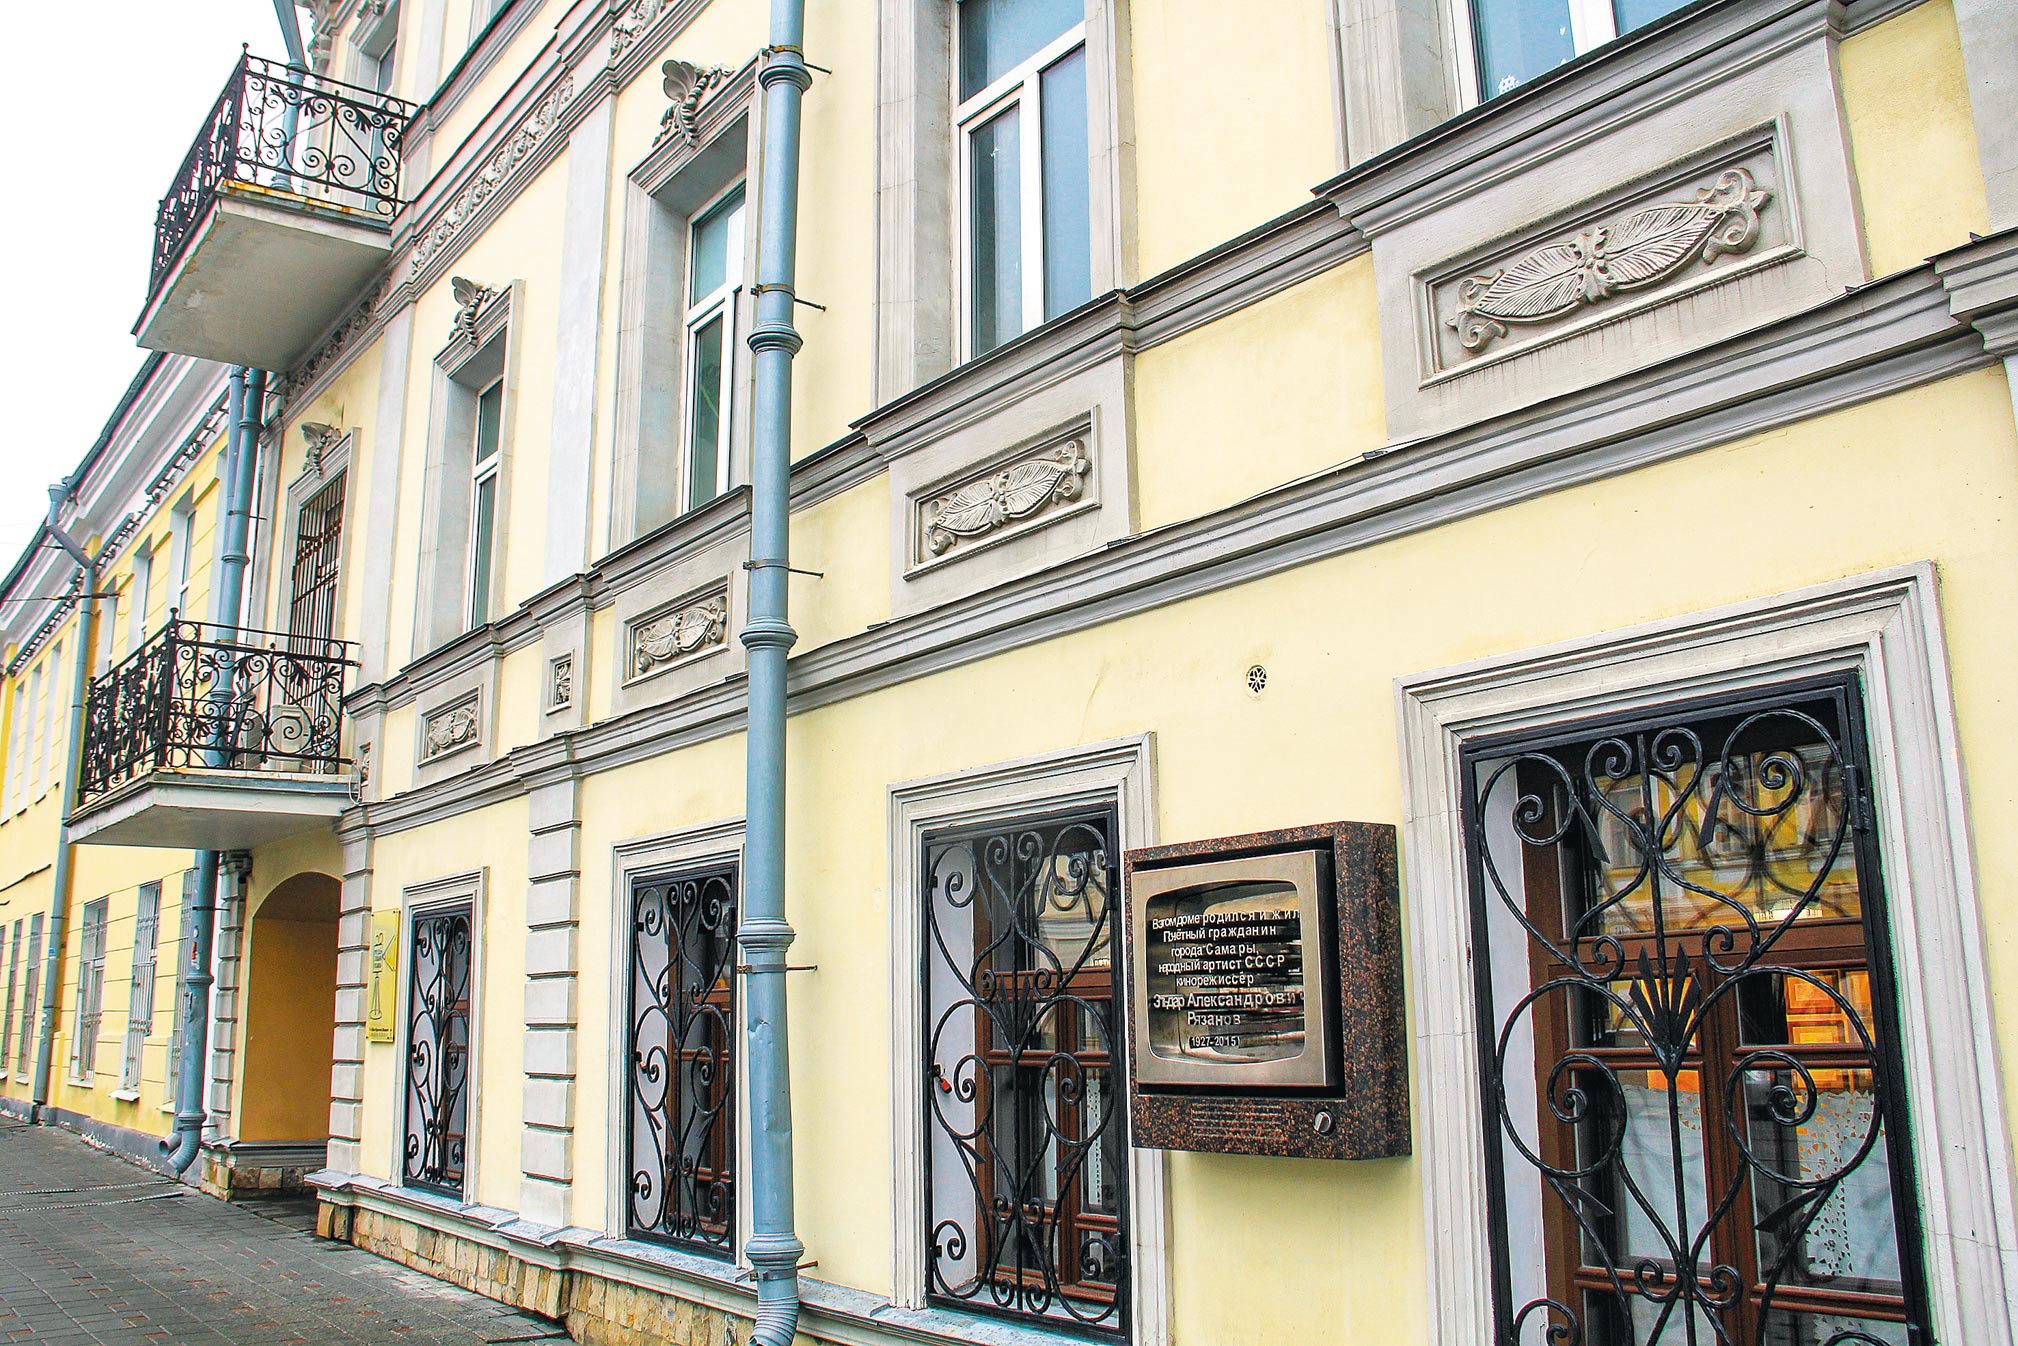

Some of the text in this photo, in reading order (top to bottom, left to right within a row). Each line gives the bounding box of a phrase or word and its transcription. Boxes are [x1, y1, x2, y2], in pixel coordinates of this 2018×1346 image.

[1176, 914, 1200, 927] доме
[1202, 911, 1255, 926] родился
[1259, 910, 1267, 921] и
[1272, 909, 1300, 921] жил
[1208, 925, 1277, 941] гражданин
[1171, 943, 1259, 959] города Самары,
[1158, 954, 1285, 975] народный артист СССР
[1176, 971, 1254, 988] кинорежиссёр
[1187, 1011, 1241, 1026] Рязанов
